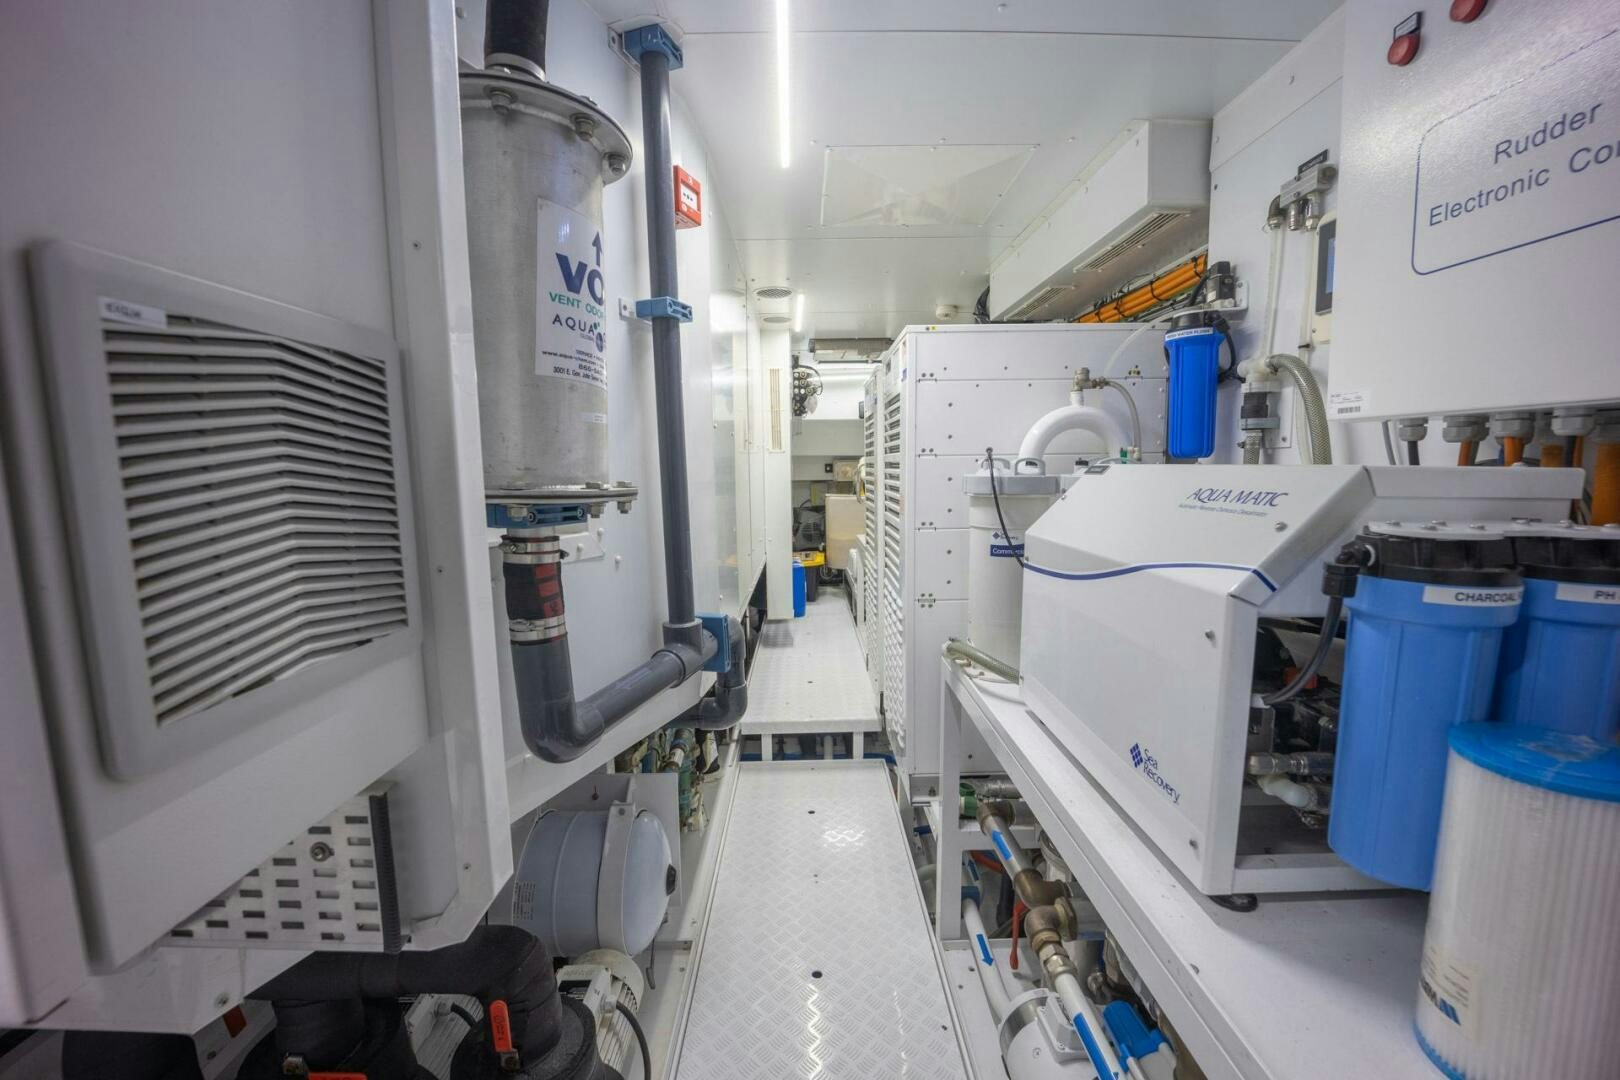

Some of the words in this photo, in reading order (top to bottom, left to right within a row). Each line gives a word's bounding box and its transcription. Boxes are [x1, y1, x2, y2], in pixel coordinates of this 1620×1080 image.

[1494, 103, 1602, 164] Rudder
[1429, 168, 1550, 226] Electronic
[549, 291, 582, 309] VENT
[552, 313, 595, 336] AQUA
[1186, 488, 1232, 504] AQUA
[1230, 490, 1289, 507] MATIC
[1594, 590, 1616, 599] PH
[1144, 748, 1158, 770] Sea
[1144, 761, 1180, 805] Recovery
